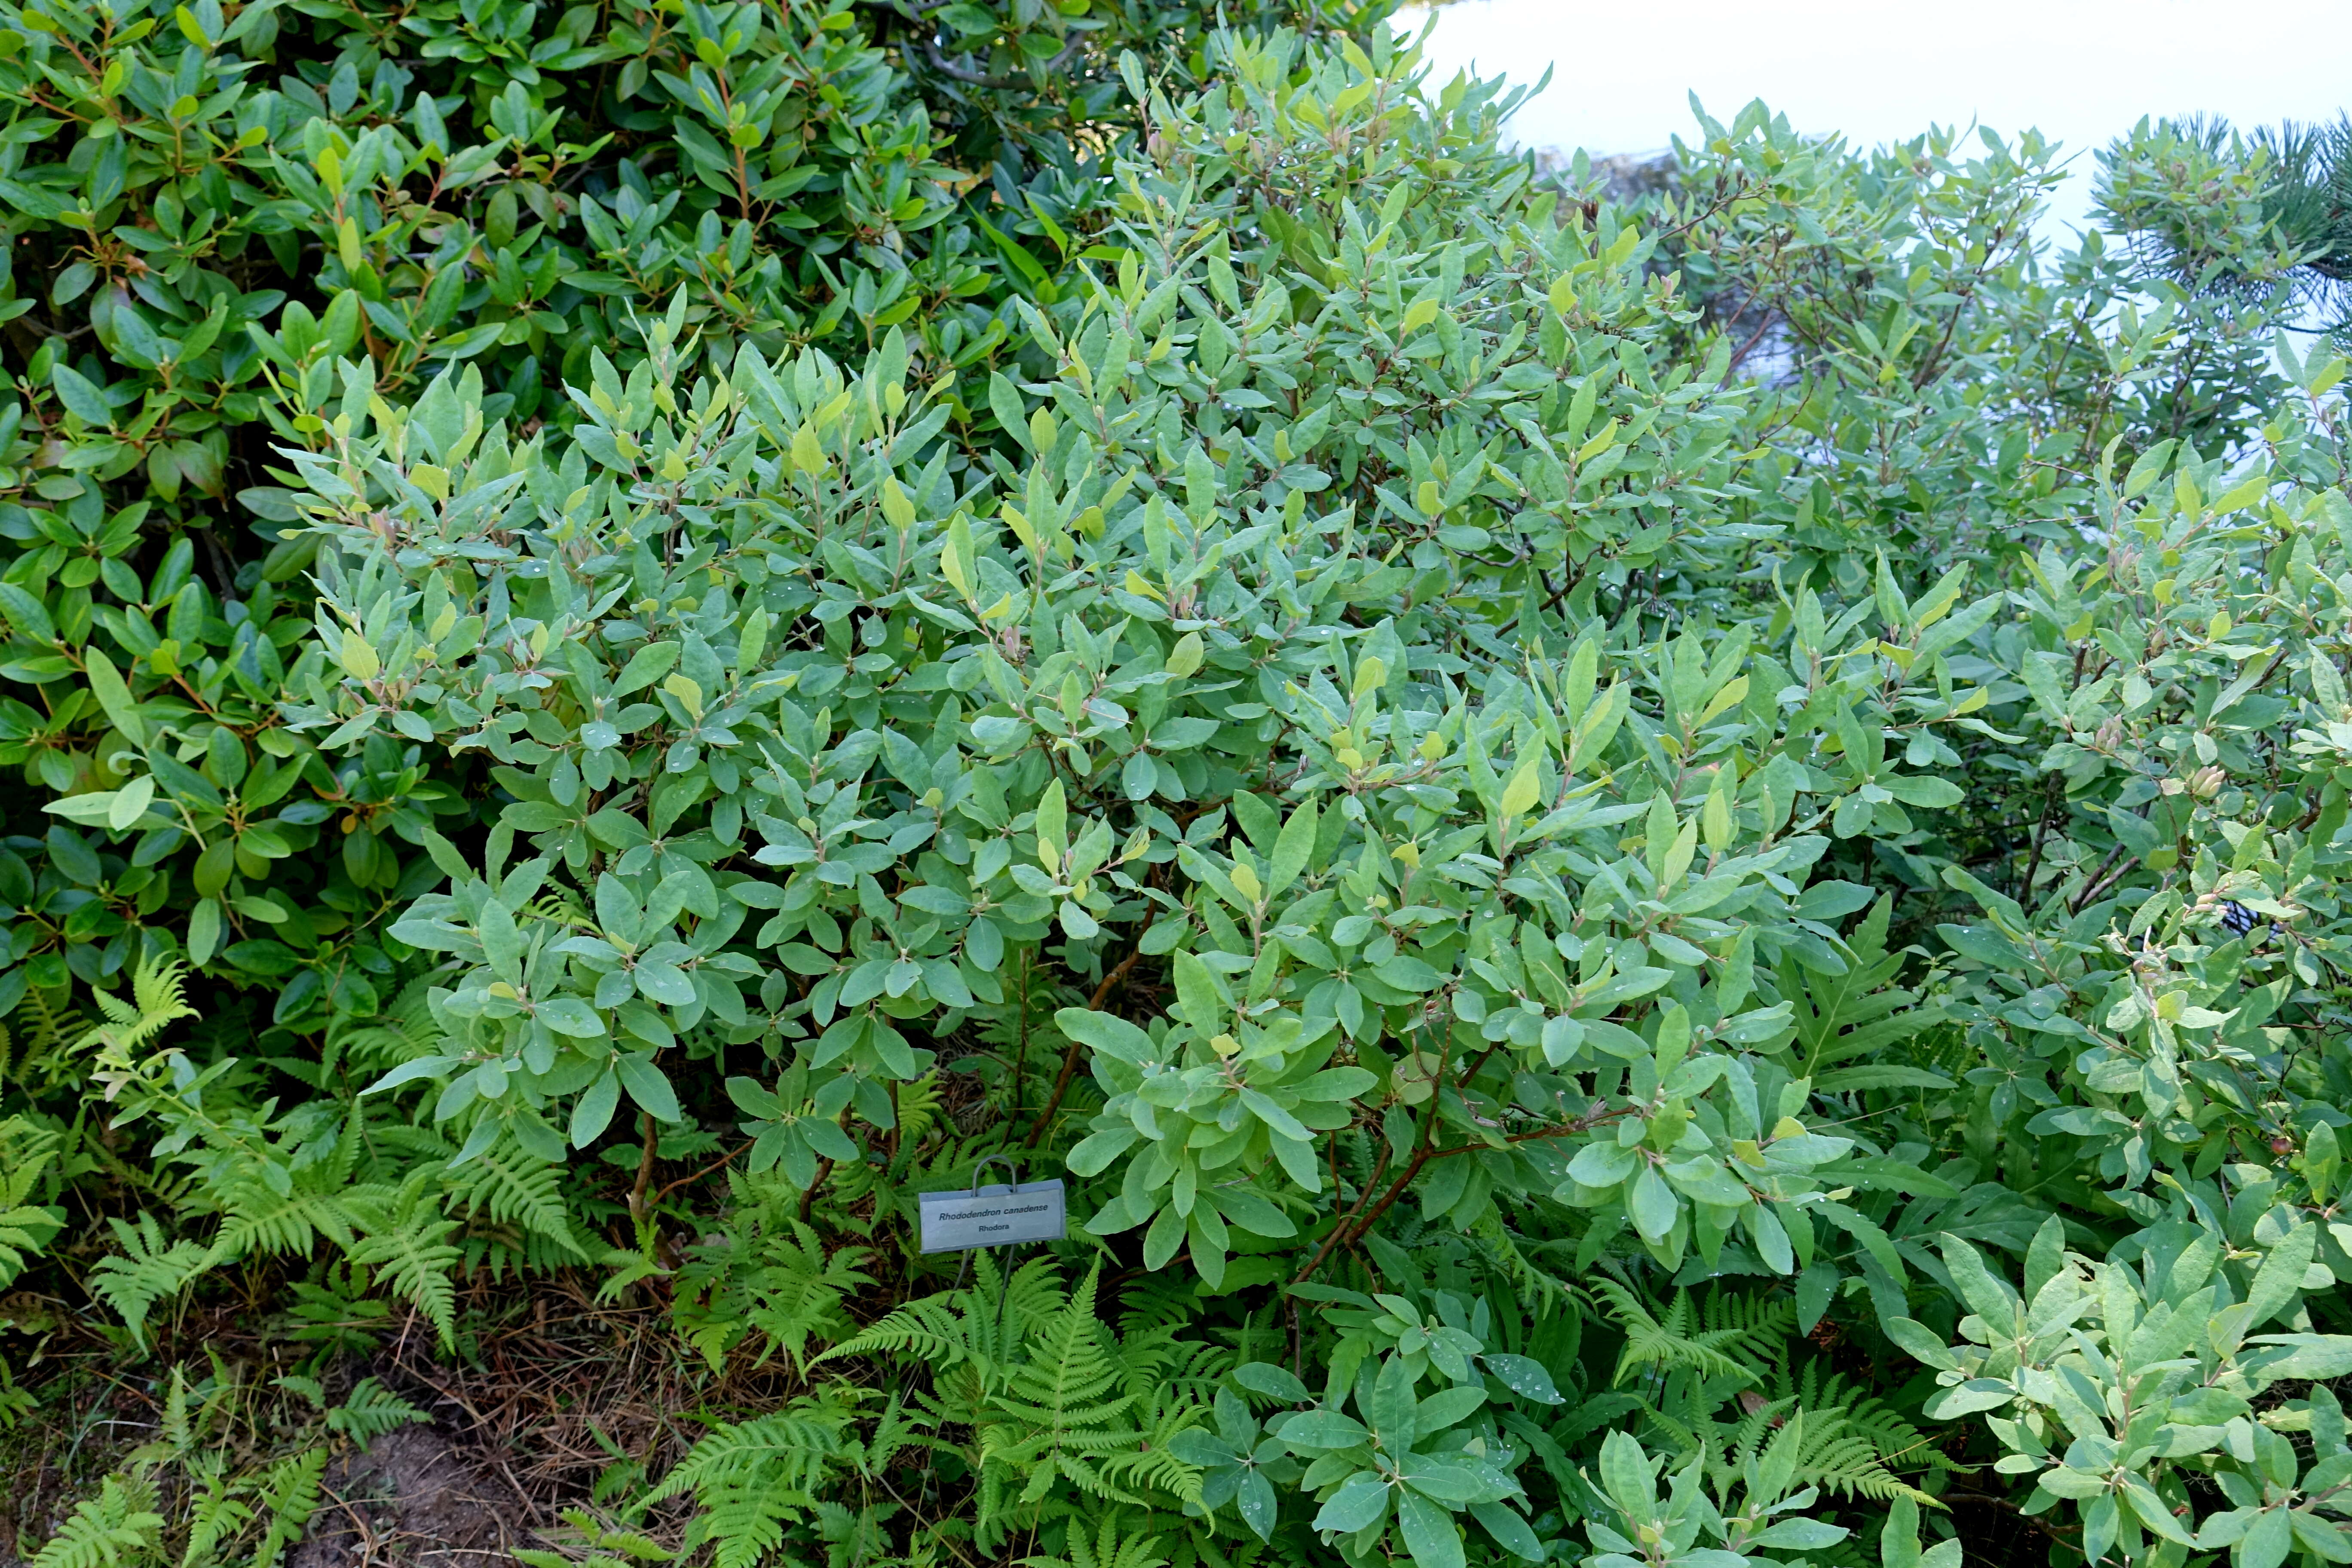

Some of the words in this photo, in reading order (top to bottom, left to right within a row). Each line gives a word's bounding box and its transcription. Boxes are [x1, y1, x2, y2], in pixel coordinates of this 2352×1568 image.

[939, 1209, 1001, 1221] Rhododendron
[1004, 1204, 1048, 1214] canadense
[979, 1224, 1009, 1232] Rhodora
